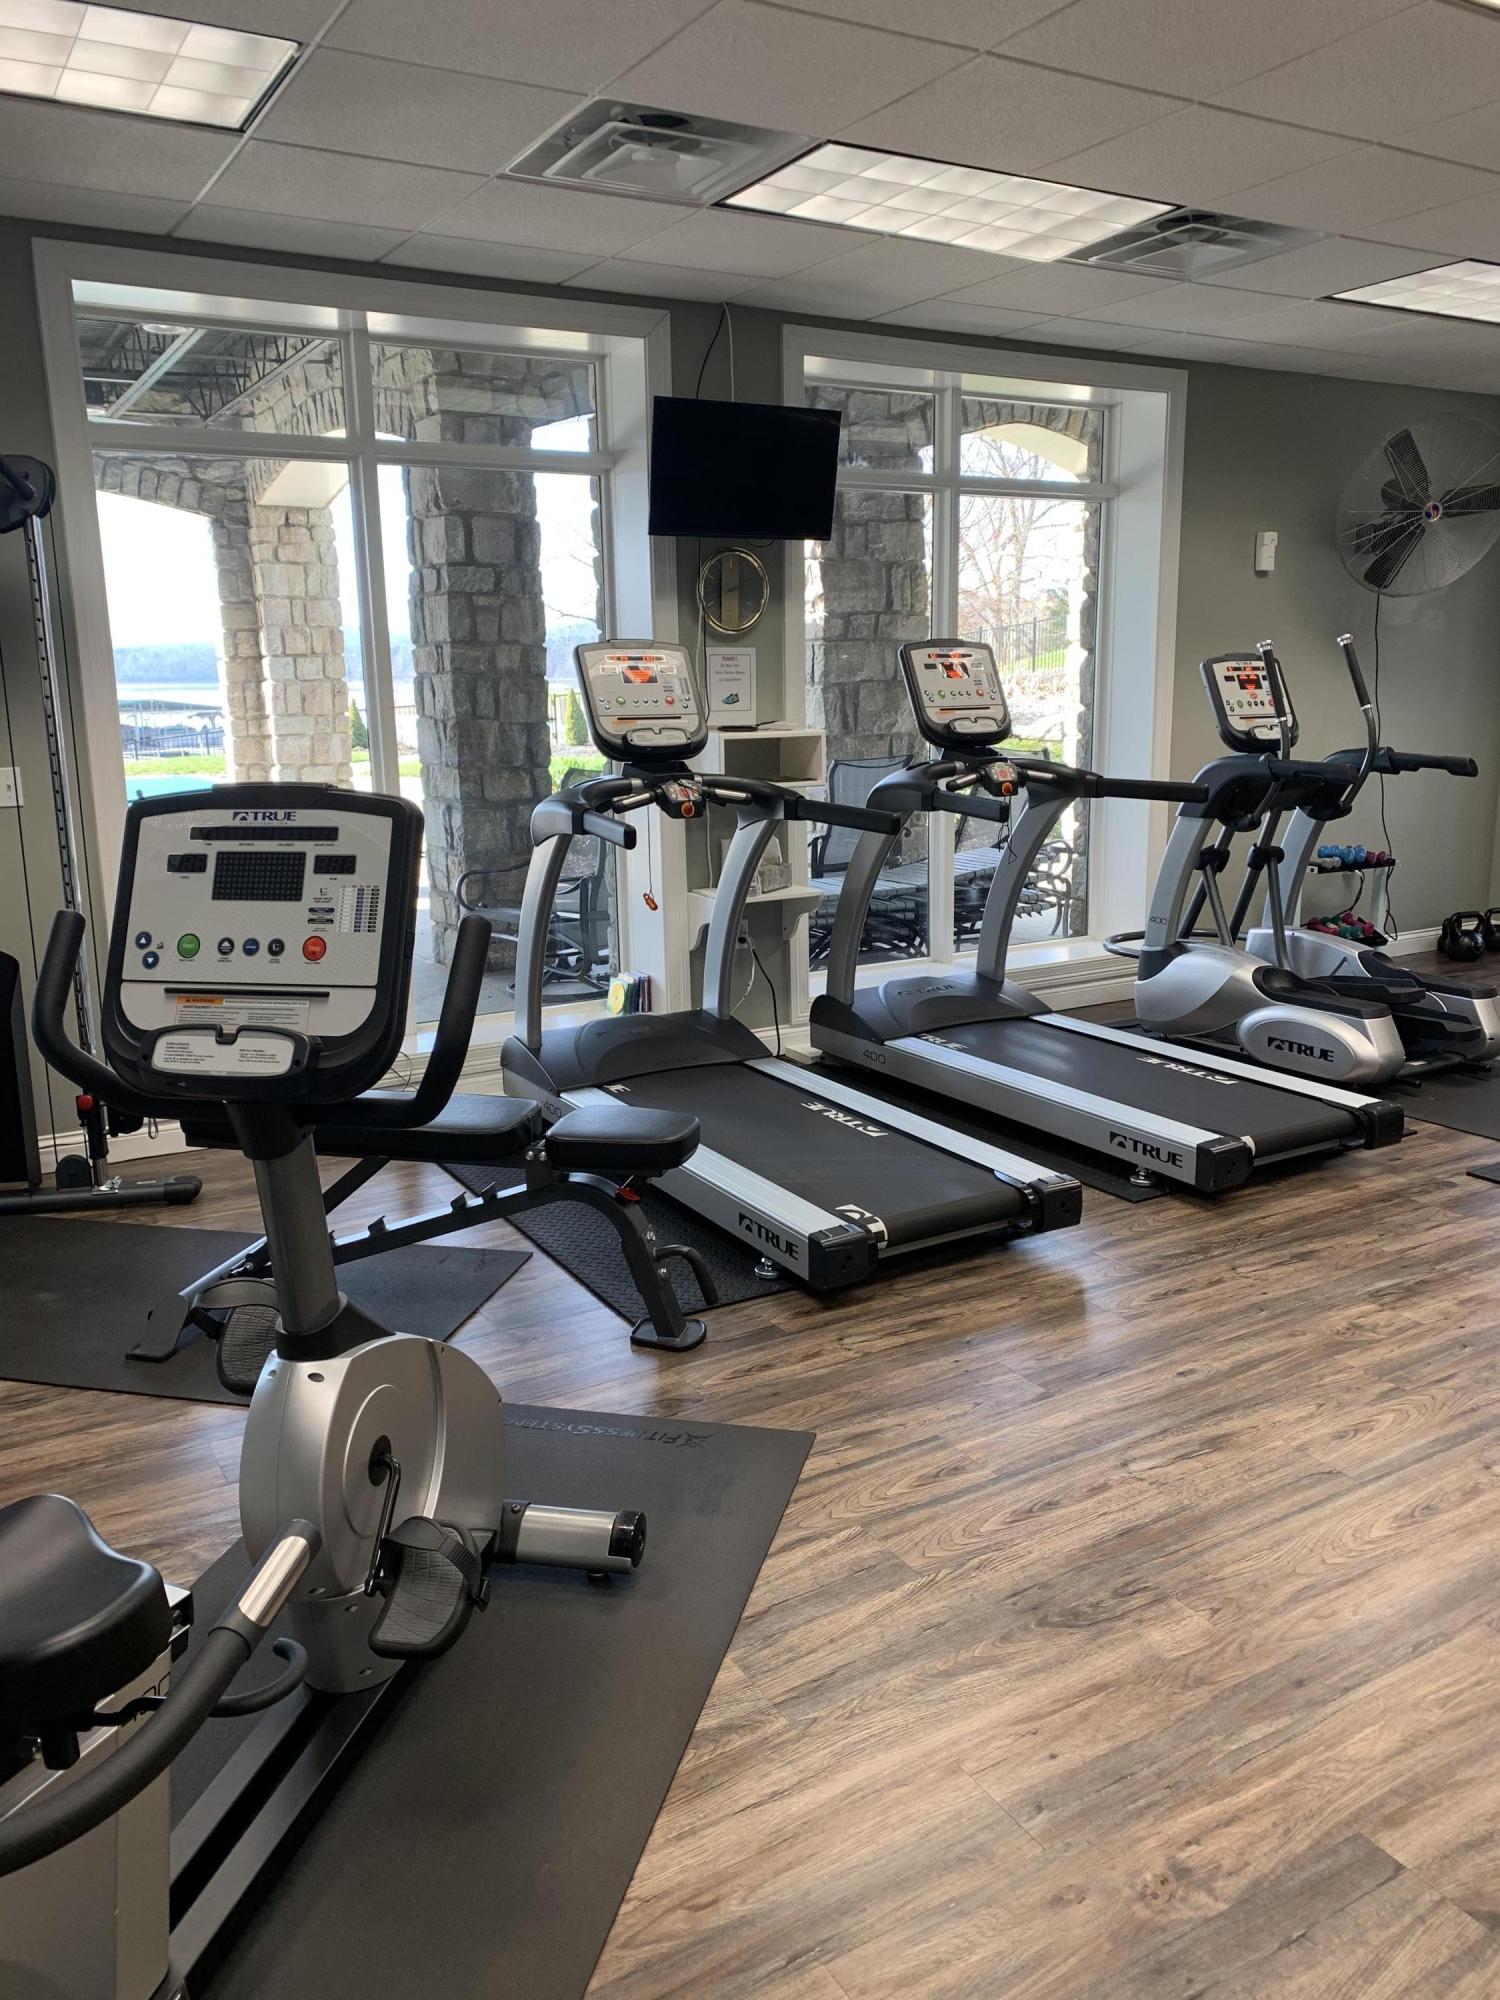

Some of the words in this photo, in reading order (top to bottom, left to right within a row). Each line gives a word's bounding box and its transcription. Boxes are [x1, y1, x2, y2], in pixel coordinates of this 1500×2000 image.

[250, 811, 297, 822] TRUE
[863, 1049, 886, 1065] 400
[1282, 1041, 1335, 1063] TRUE
[543, 1101, 562, 1118] 400
[800, 1102, 863, 1129] TRUE
[1129, 1140, 1183, 1169] TRUE
[753, 1220, 800, 1261] TRUE
